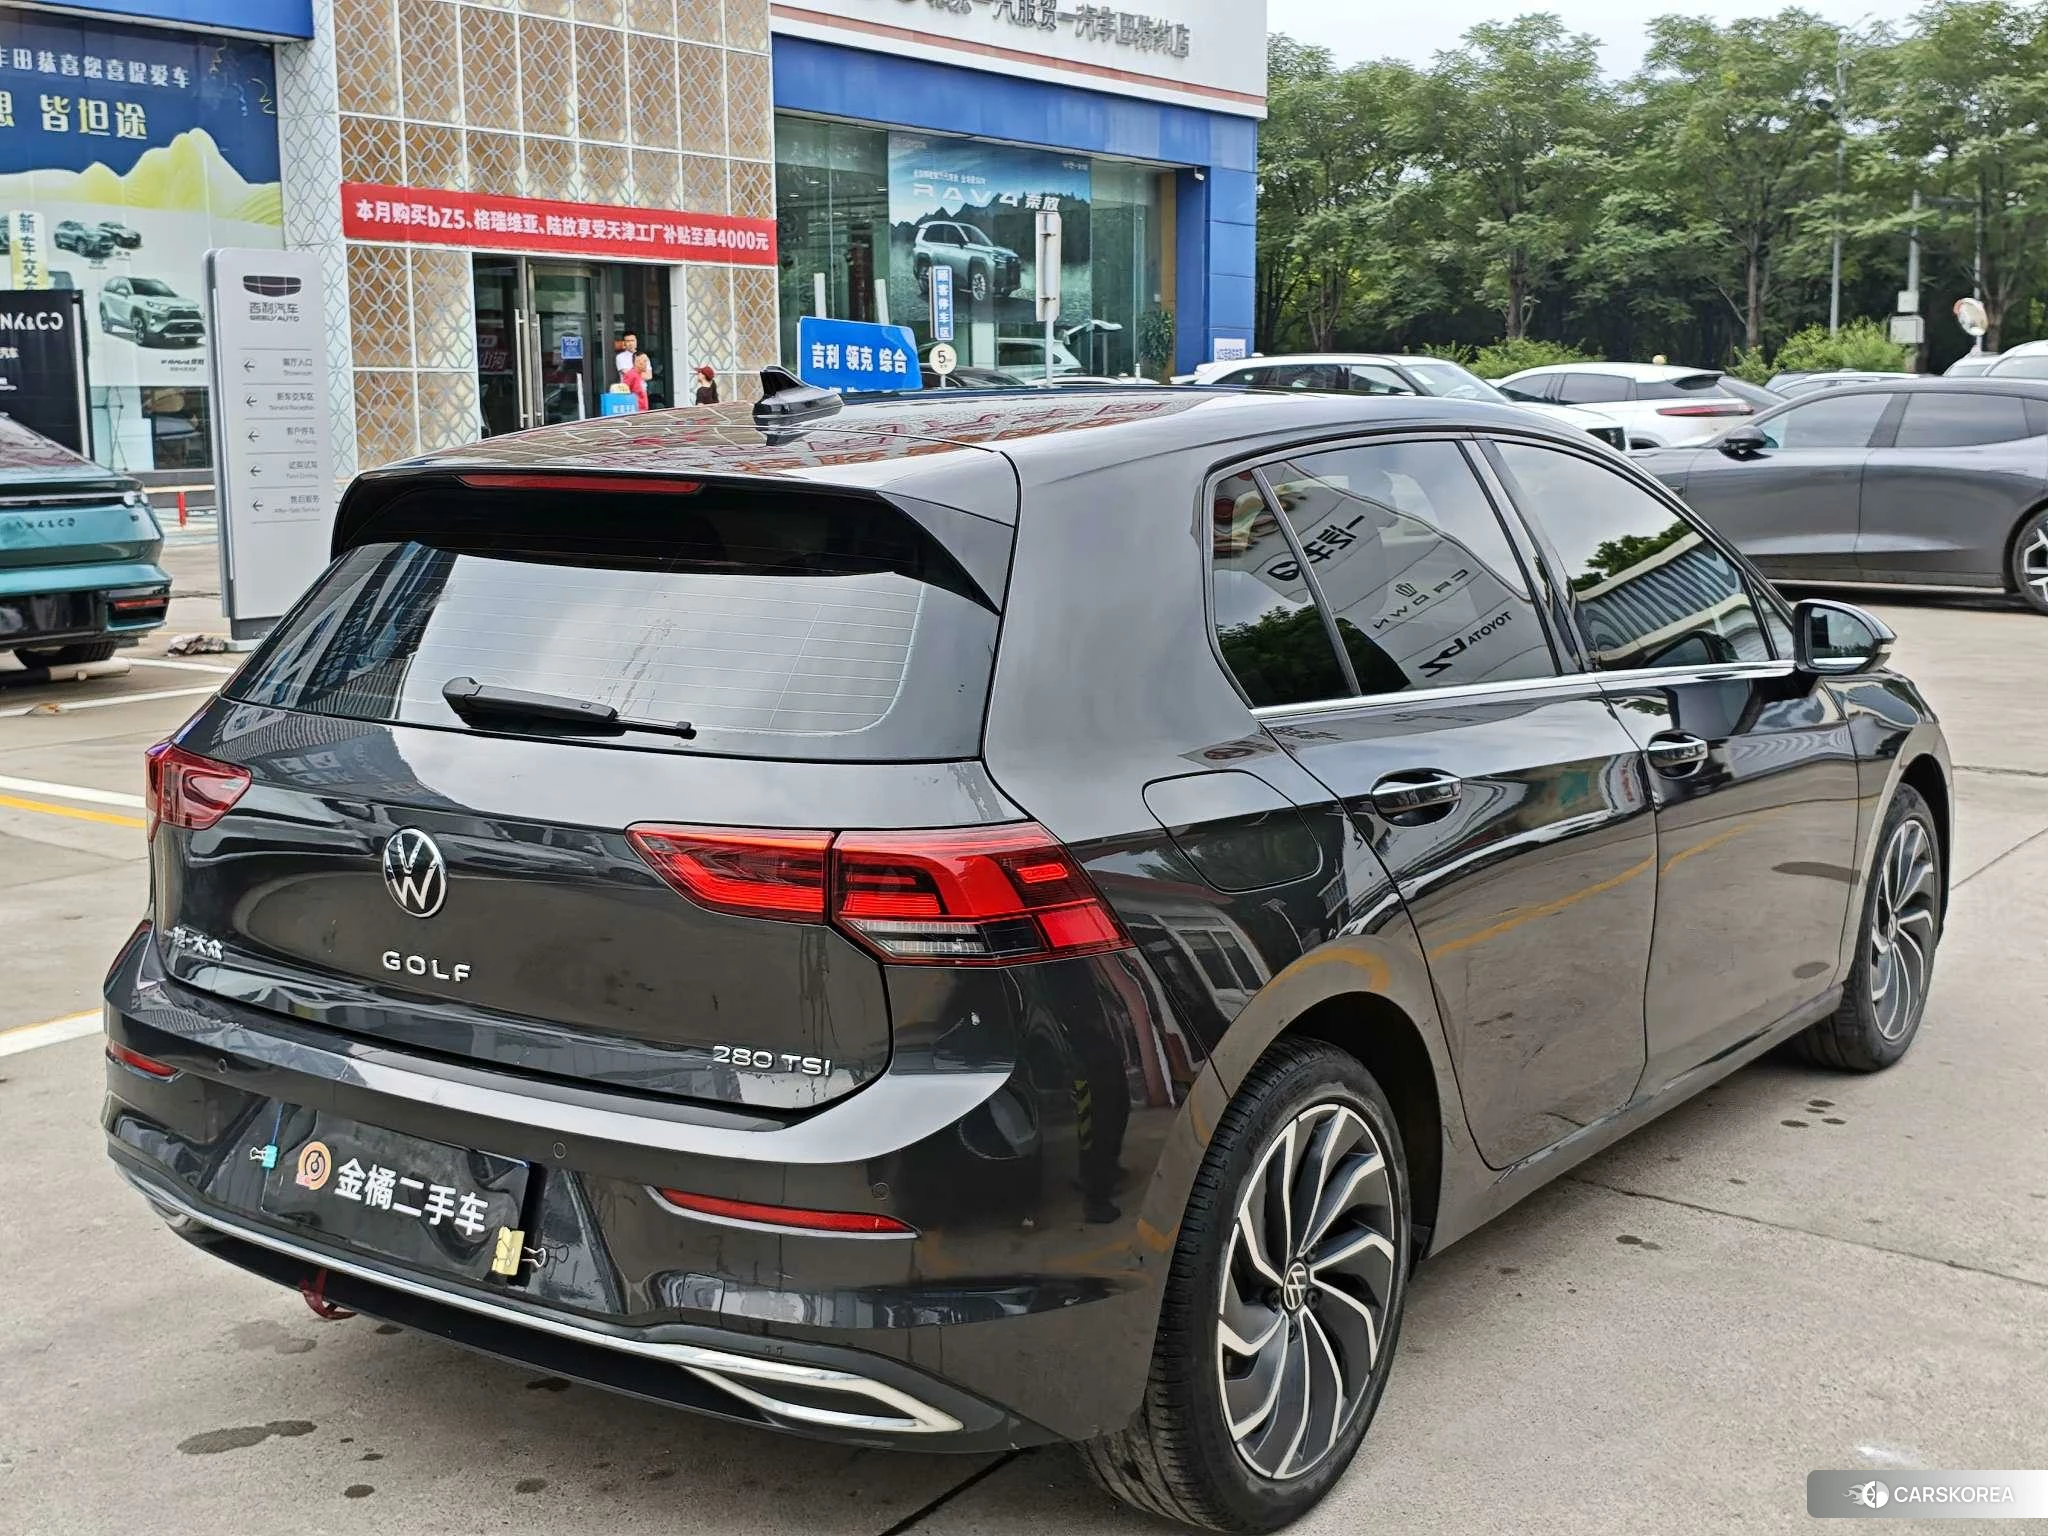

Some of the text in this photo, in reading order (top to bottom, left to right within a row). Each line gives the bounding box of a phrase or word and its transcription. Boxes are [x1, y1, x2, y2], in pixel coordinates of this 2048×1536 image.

[811, 341, 907, 374] 吉利 领克 综合
[937, 350, 946, 364] 5
[382, 950, 471, 982] GOLF
[712, 1045, 831, 1076] 280 TSI
[334, 1157, 489, 1237] 金橘二手车
